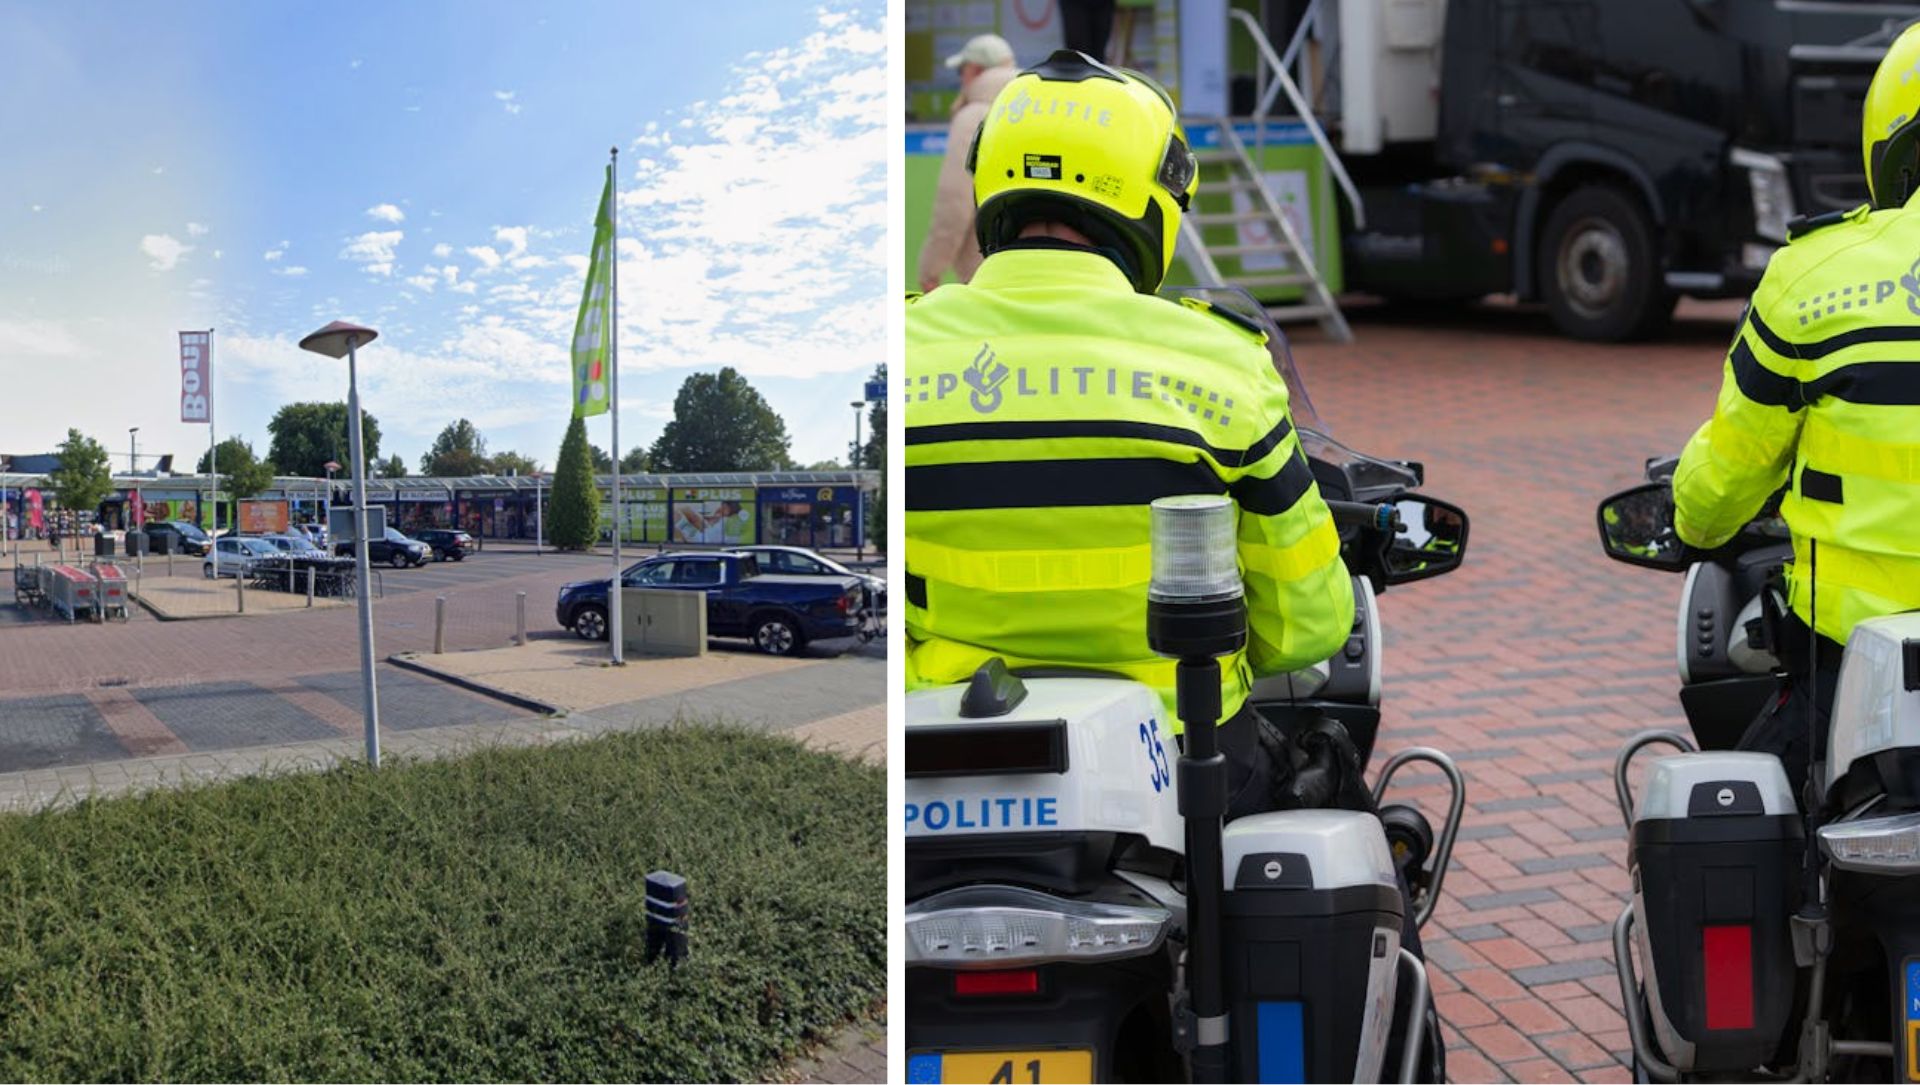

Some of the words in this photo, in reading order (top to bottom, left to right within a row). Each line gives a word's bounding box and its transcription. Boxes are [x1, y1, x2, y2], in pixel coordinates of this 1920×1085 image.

[995, 89, 1112, 127] POLITIE
[937, 343, 1153, 413] POLITIE
[699, 489, 742, 500] PLUS
[1139, 718, 1170, 792] 35
[905, 798, 1058, 831] POLITIE
